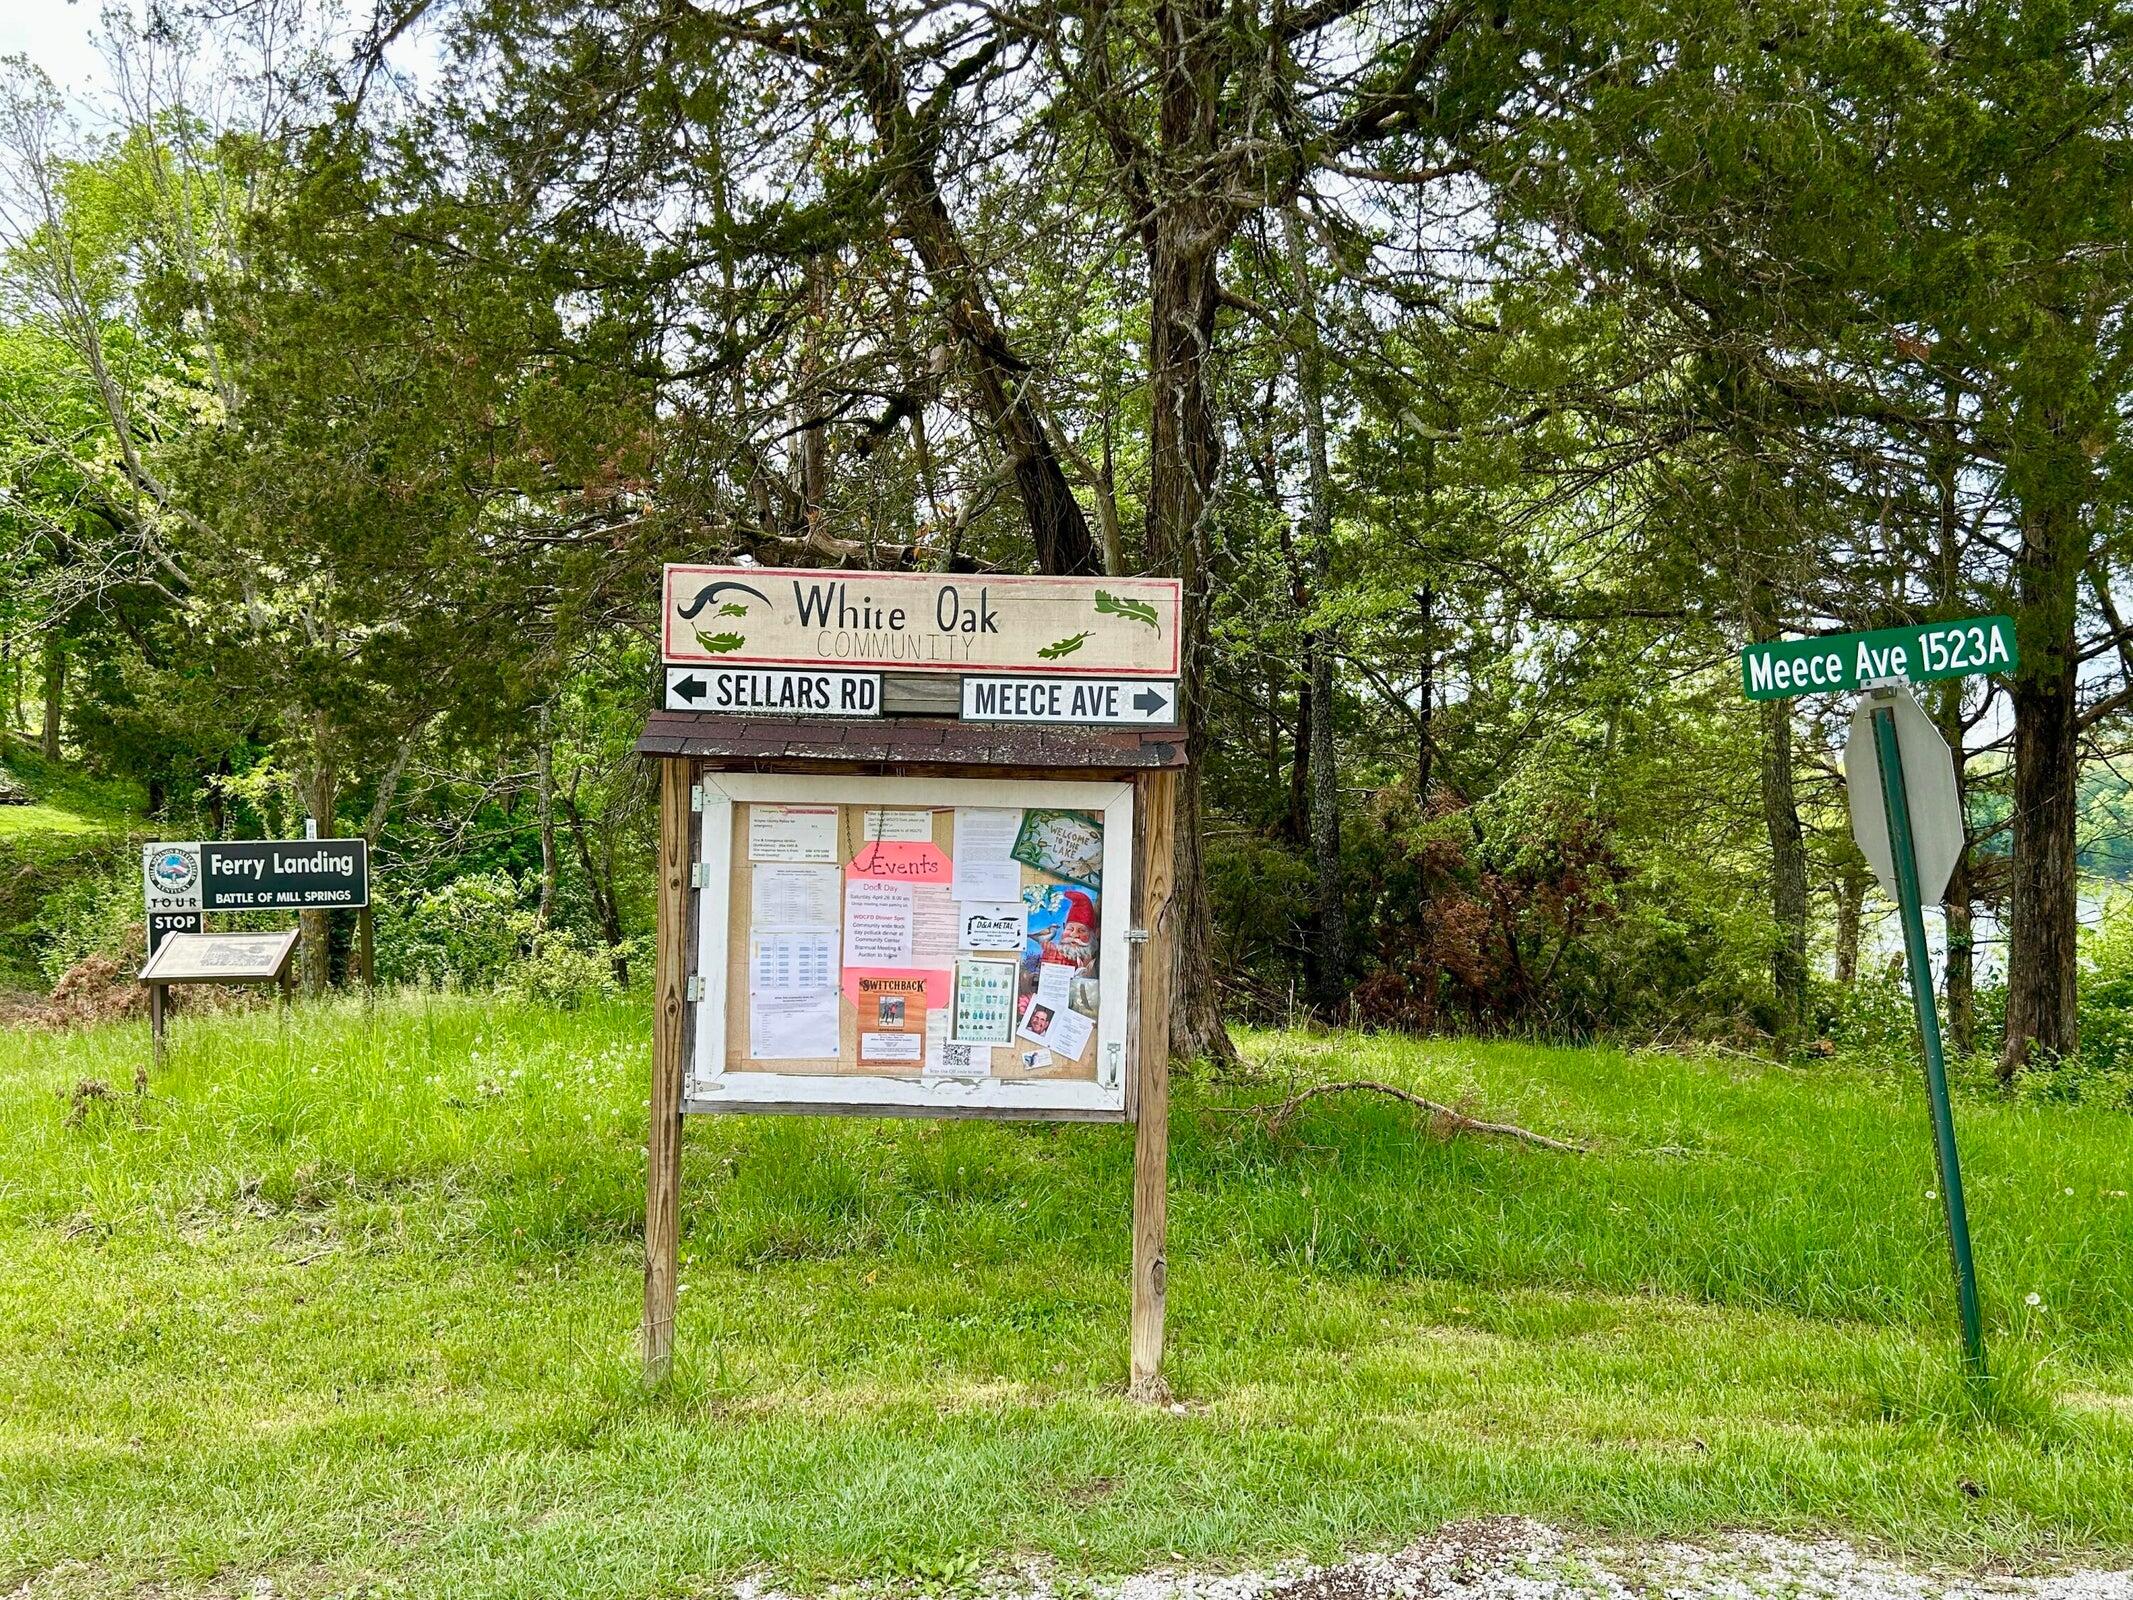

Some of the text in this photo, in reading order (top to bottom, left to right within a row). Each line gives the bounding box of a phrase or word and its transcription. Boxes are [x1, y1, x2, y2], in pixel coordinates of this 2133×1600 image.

[793, 580, 998, 634] White Oak
[816, 629, 976, 661] COMMUNITY
[1749, 624, 2010, 692] Meece Ave 1523A
[717, 674, 876, 710] SELLARS RD
[975, 684, 1119, 717] MEECE AVE
[1050, 825, 1090, 846] WELCOME
[1055, 837, 1080, 851] TO THE
[1052, 844, 1077, 859] LAKE
[211, 851, 354, 880] Ferry Landing
[872, 854, 938, 875] Events
[215, 890, 351, 904] BATTLE OF MILL SPRINGS
[863, 883, 898, 893] Dock Day
[151, 898, 196, 908] TOUR
[154, 916, 196, 929] STOP
[976, 921, 1014, 930] D&A METAL
[862, 979, 925, 992] SWITCHBACK
